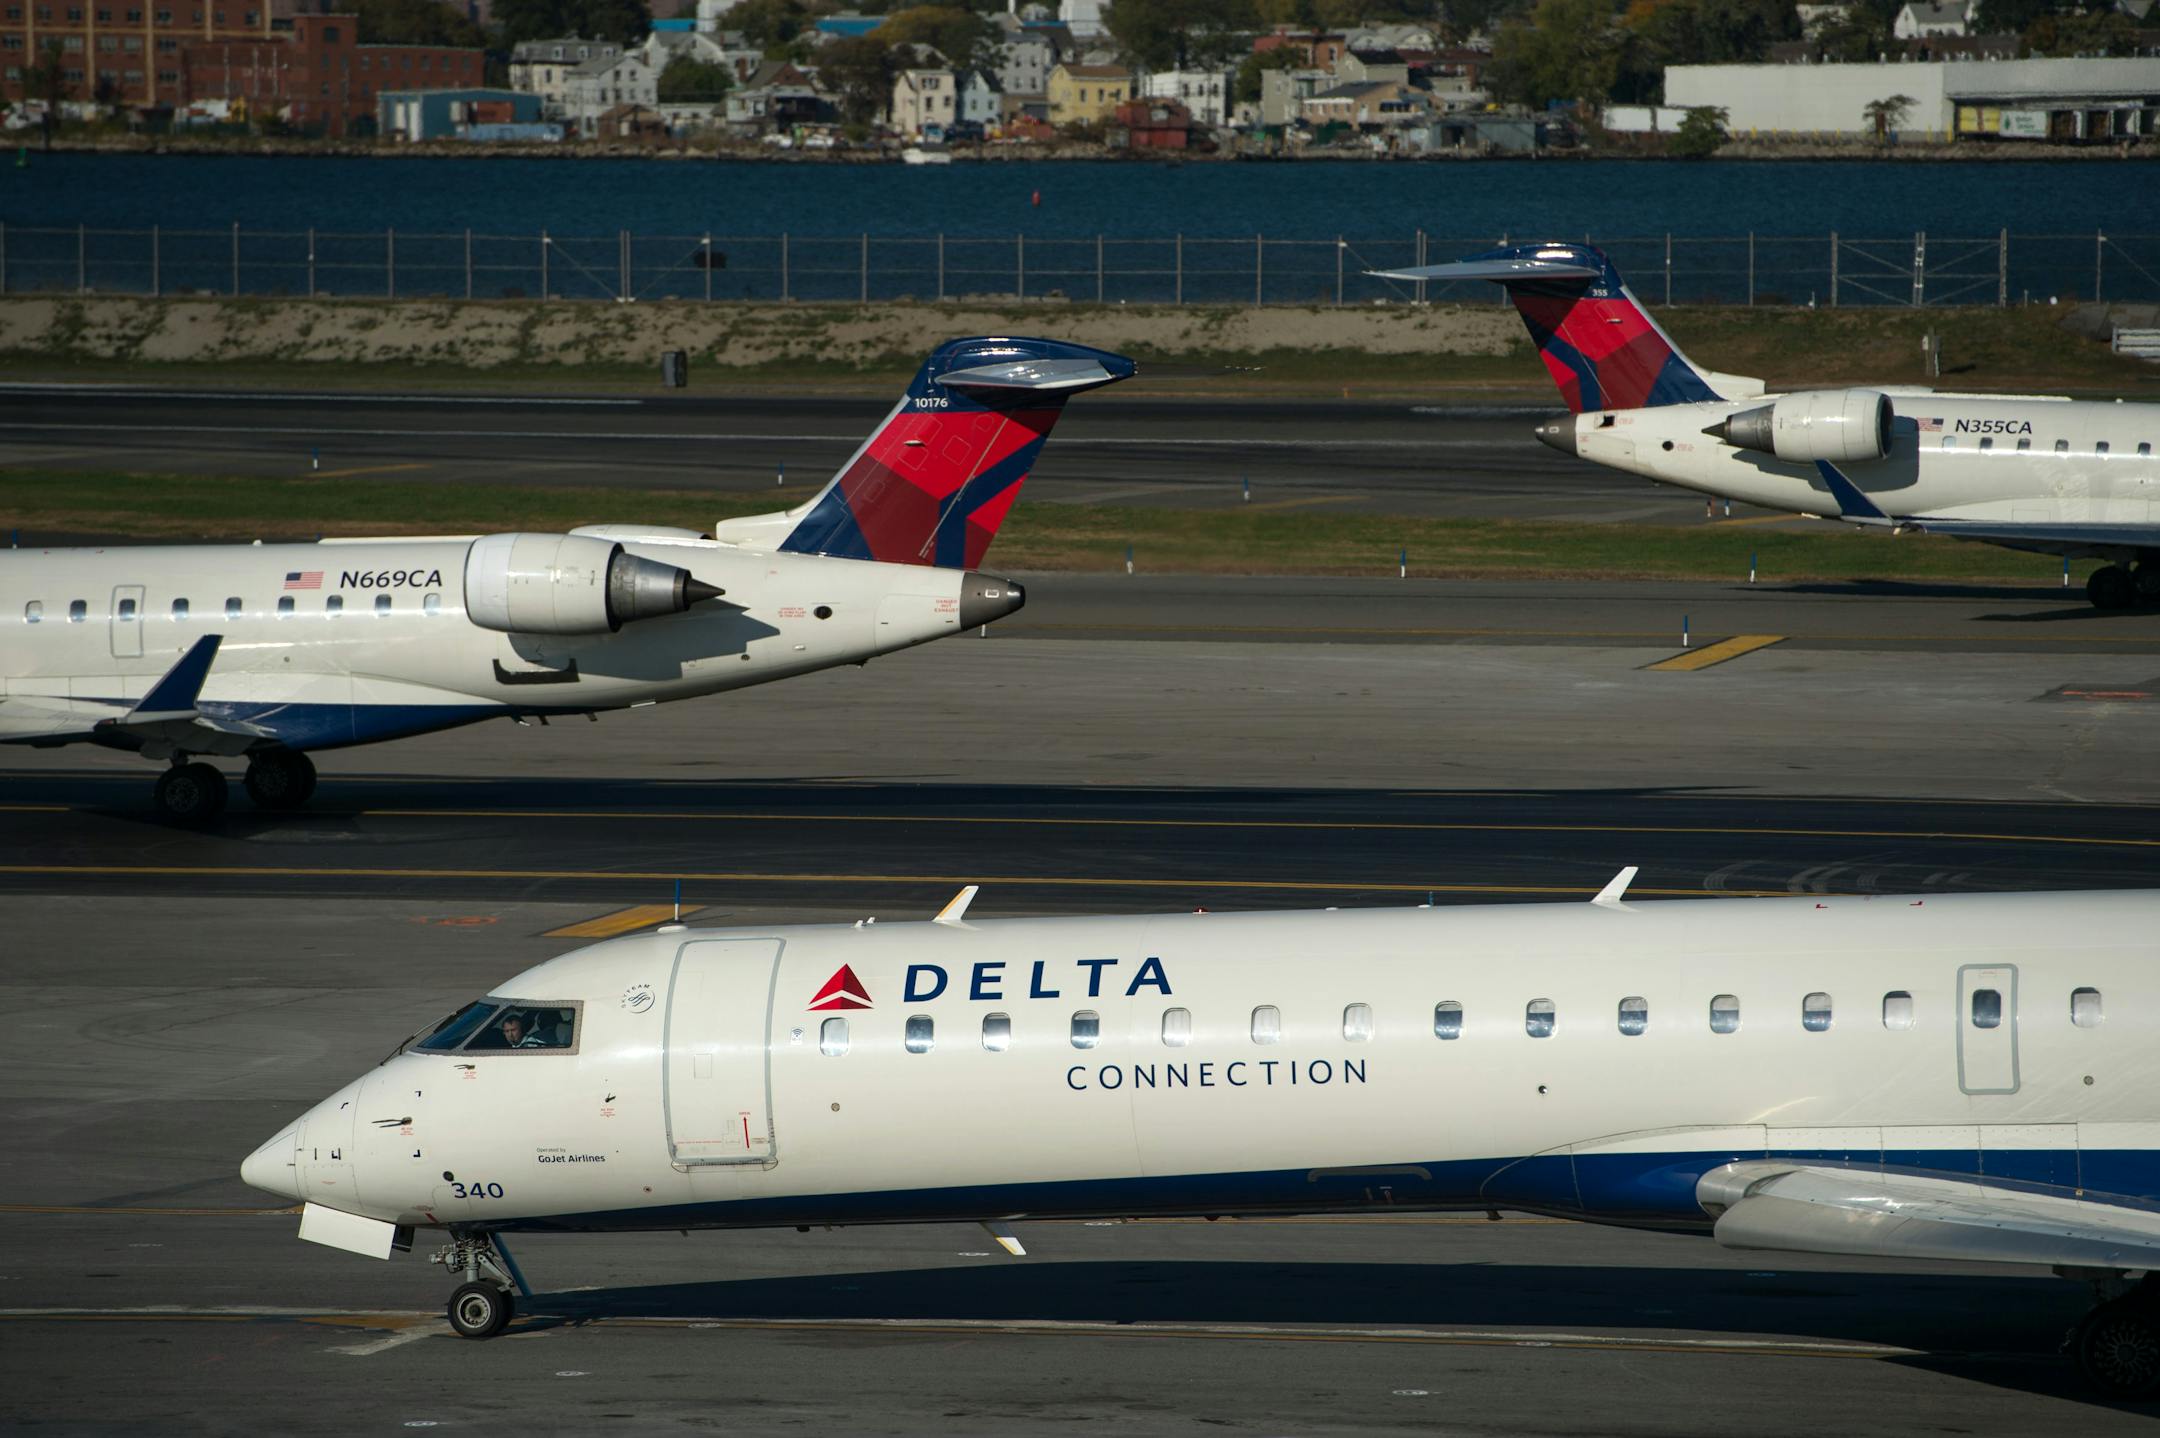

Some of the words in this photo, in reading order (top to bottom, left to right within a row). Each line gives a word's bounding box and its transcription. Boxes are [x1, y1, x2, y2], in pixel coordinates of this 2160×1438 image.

[915, 397, 948, 408] 10176
[1955, 418, 2032, 434] N355CA
[340, 569, 442, 588] N669CA
[903, 957, 1173, 1003] DELTA
[1066, 1059, 1368, 1091] CONNECTION
[538, 1155, 566, 1163] GoJet
[568, 1154, 605, 1163] Airlines
[452, 1181, 504, 1199] 340
